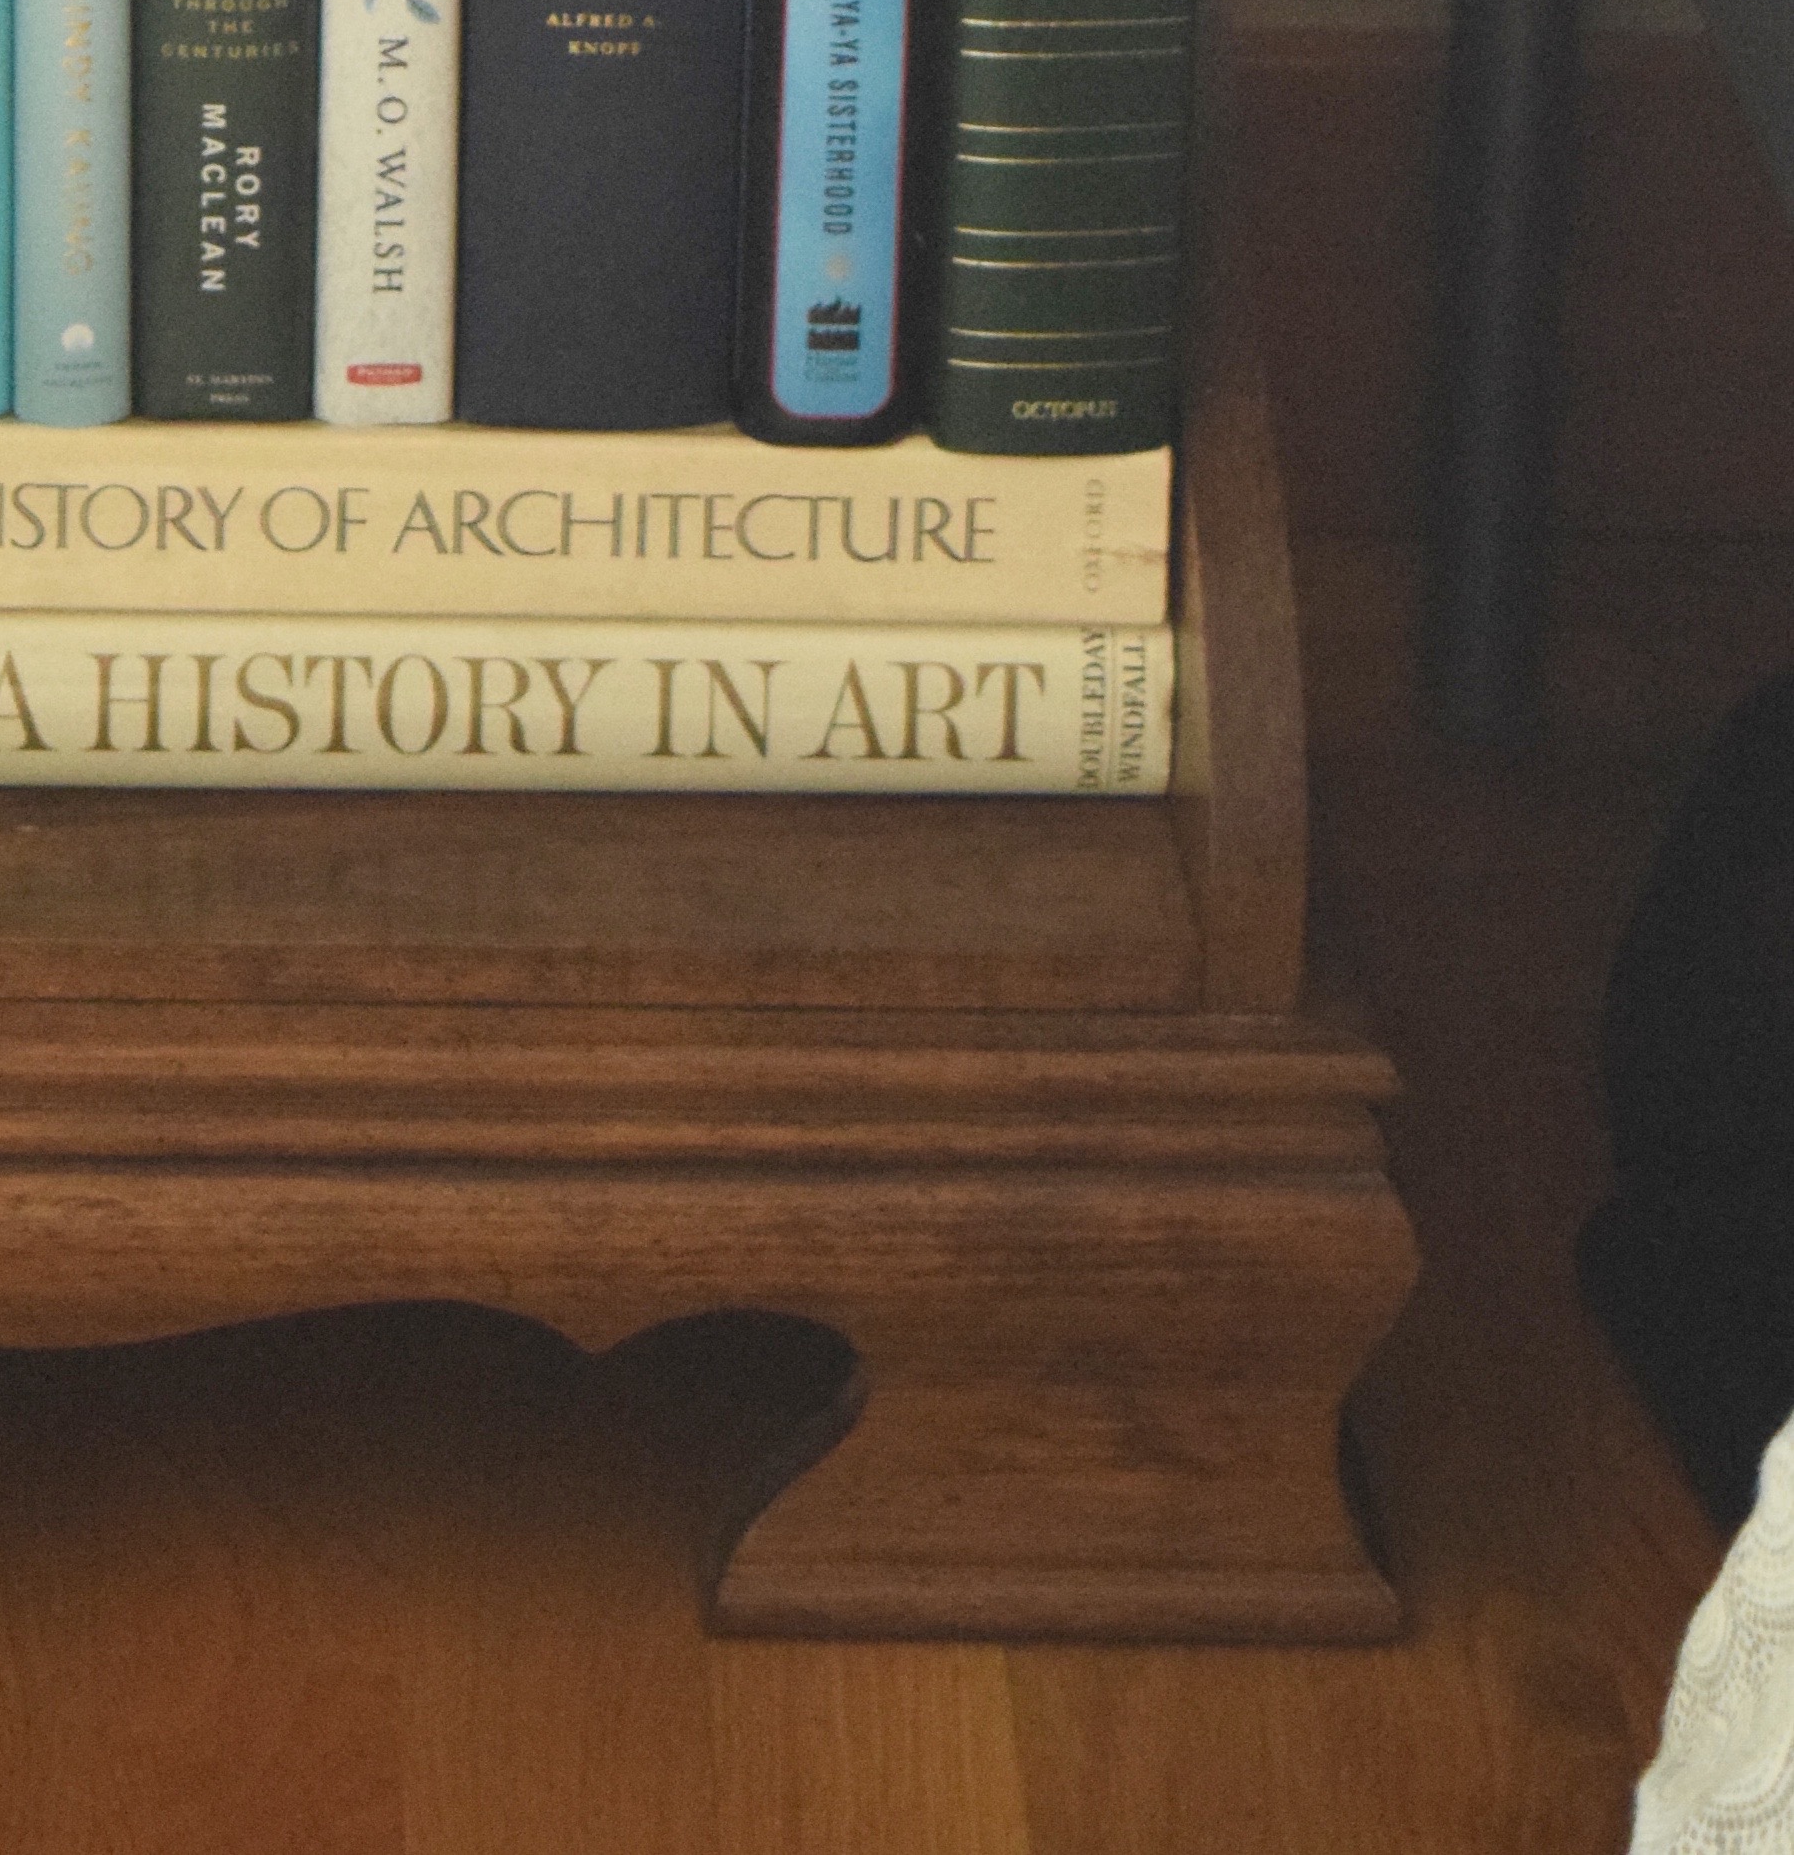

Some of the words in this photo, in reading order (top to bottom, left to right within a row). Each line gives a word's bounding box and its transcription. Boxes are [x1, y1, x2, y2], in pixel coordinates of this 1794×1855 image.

[160, 42, 299, 59] CENTURIES
[209, 19, 253, 34] THE
[377, 35, 408, 84] M.
[546, 12, 634, 29] ALFRED
[829, 0, 861, 68] YA-YA
[376, 95, 408, 135] O.
[821, 78, 860, 236] SISTERHOOD
[63, 129, 93, 276] KALING
[200, 102, 227, 292] MACLEAN
[235, 145, 261, 251] RORY
[372, 147, 408, 295] WALSH
[260, 485, 373, 553] OF
[392, 488, 998, 564] ARCHITECTURE
[84, 651, 618, 758] HISTORY
[641, 656, 791, 761] IN
[797, 657, 1048, 763] ART
[1077, 627, 1106, 790] DOUBLEDAY
[1117, 636, 1147, 783] WINDFALL
